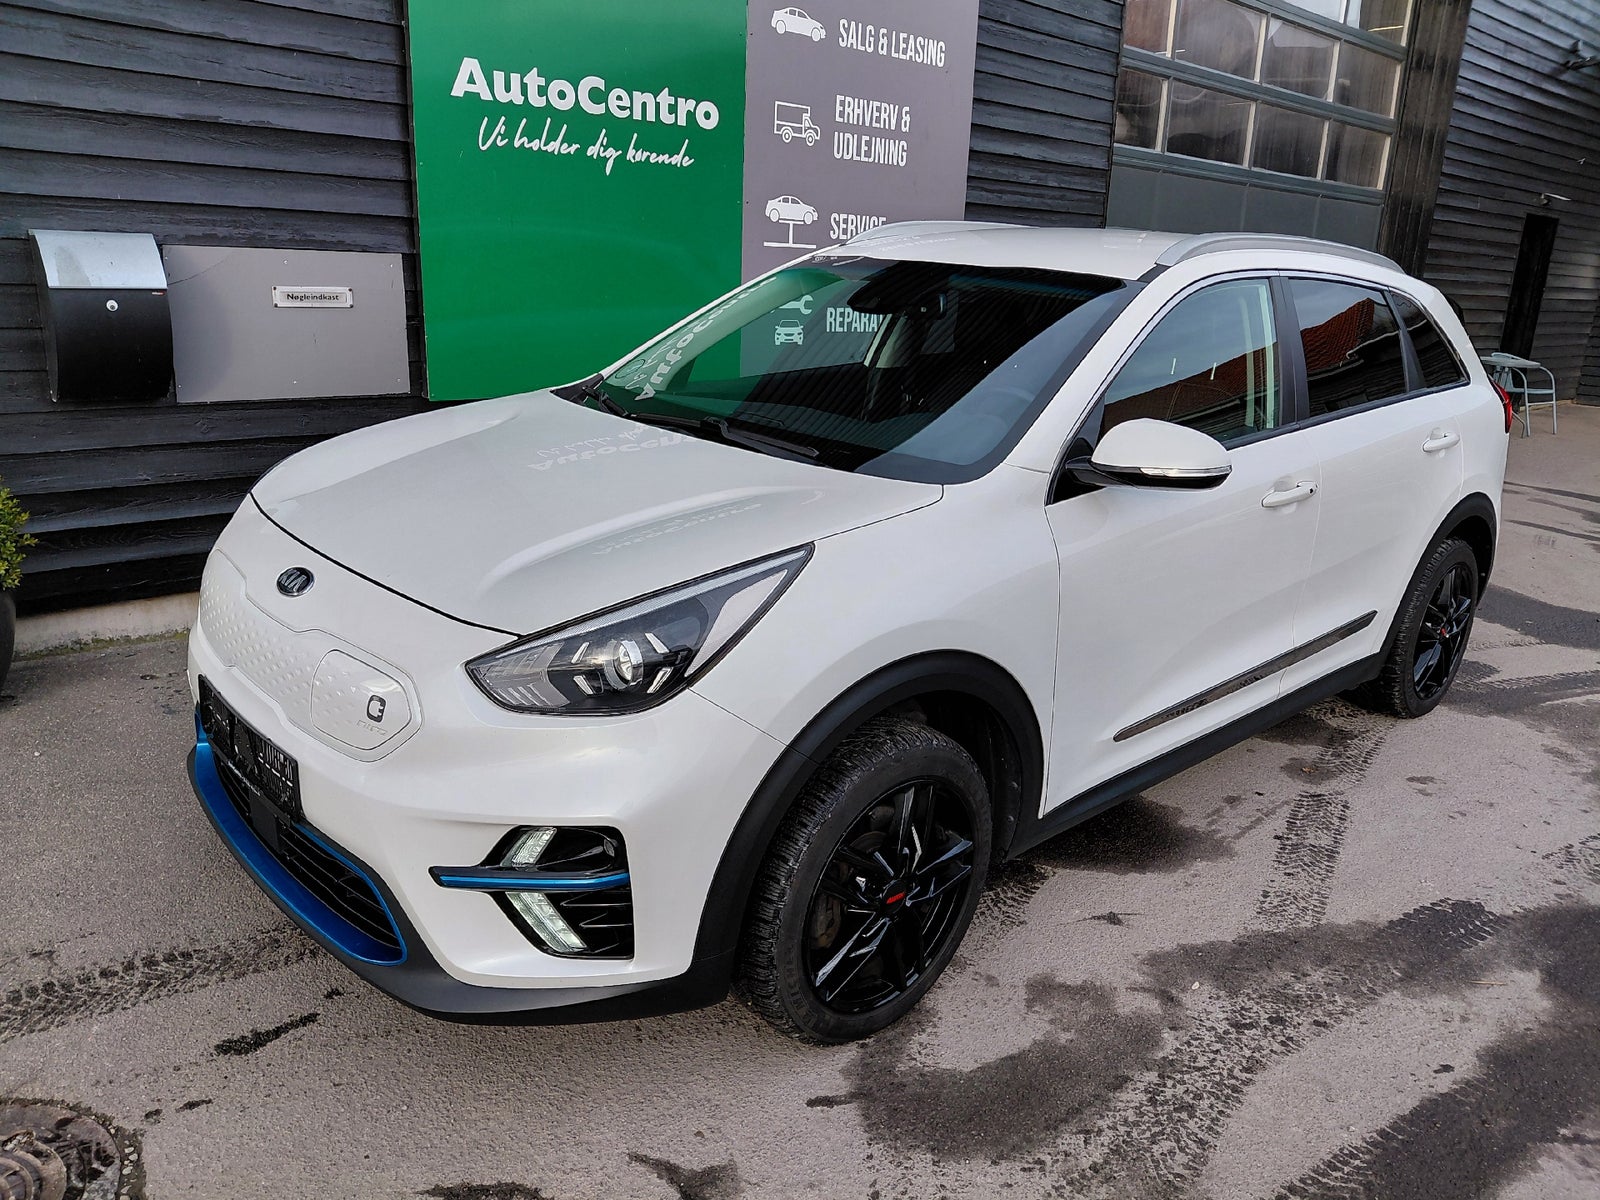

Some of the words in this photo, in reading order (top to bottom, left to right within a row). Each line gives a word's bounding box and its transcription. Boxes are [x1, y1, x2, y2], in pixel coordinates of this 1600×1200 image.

[838, 18, 875, 53] SALG
[878, 27, 888, 56] &
[891, 30, 946, 67] LEASING
[450, 56, 720, 130] AutoCentro
[835, 94, 899, 130] ERHVERV
[901, 106, 911, 133] &
[478, 115, 508, 151] Vi
[513, 117, 581, 155] holder
[586, 128, 622, 176] dig
[833, 131, 907, 167] UDLEJNING
[286, 293, 340, 301] Nøgleindkast
